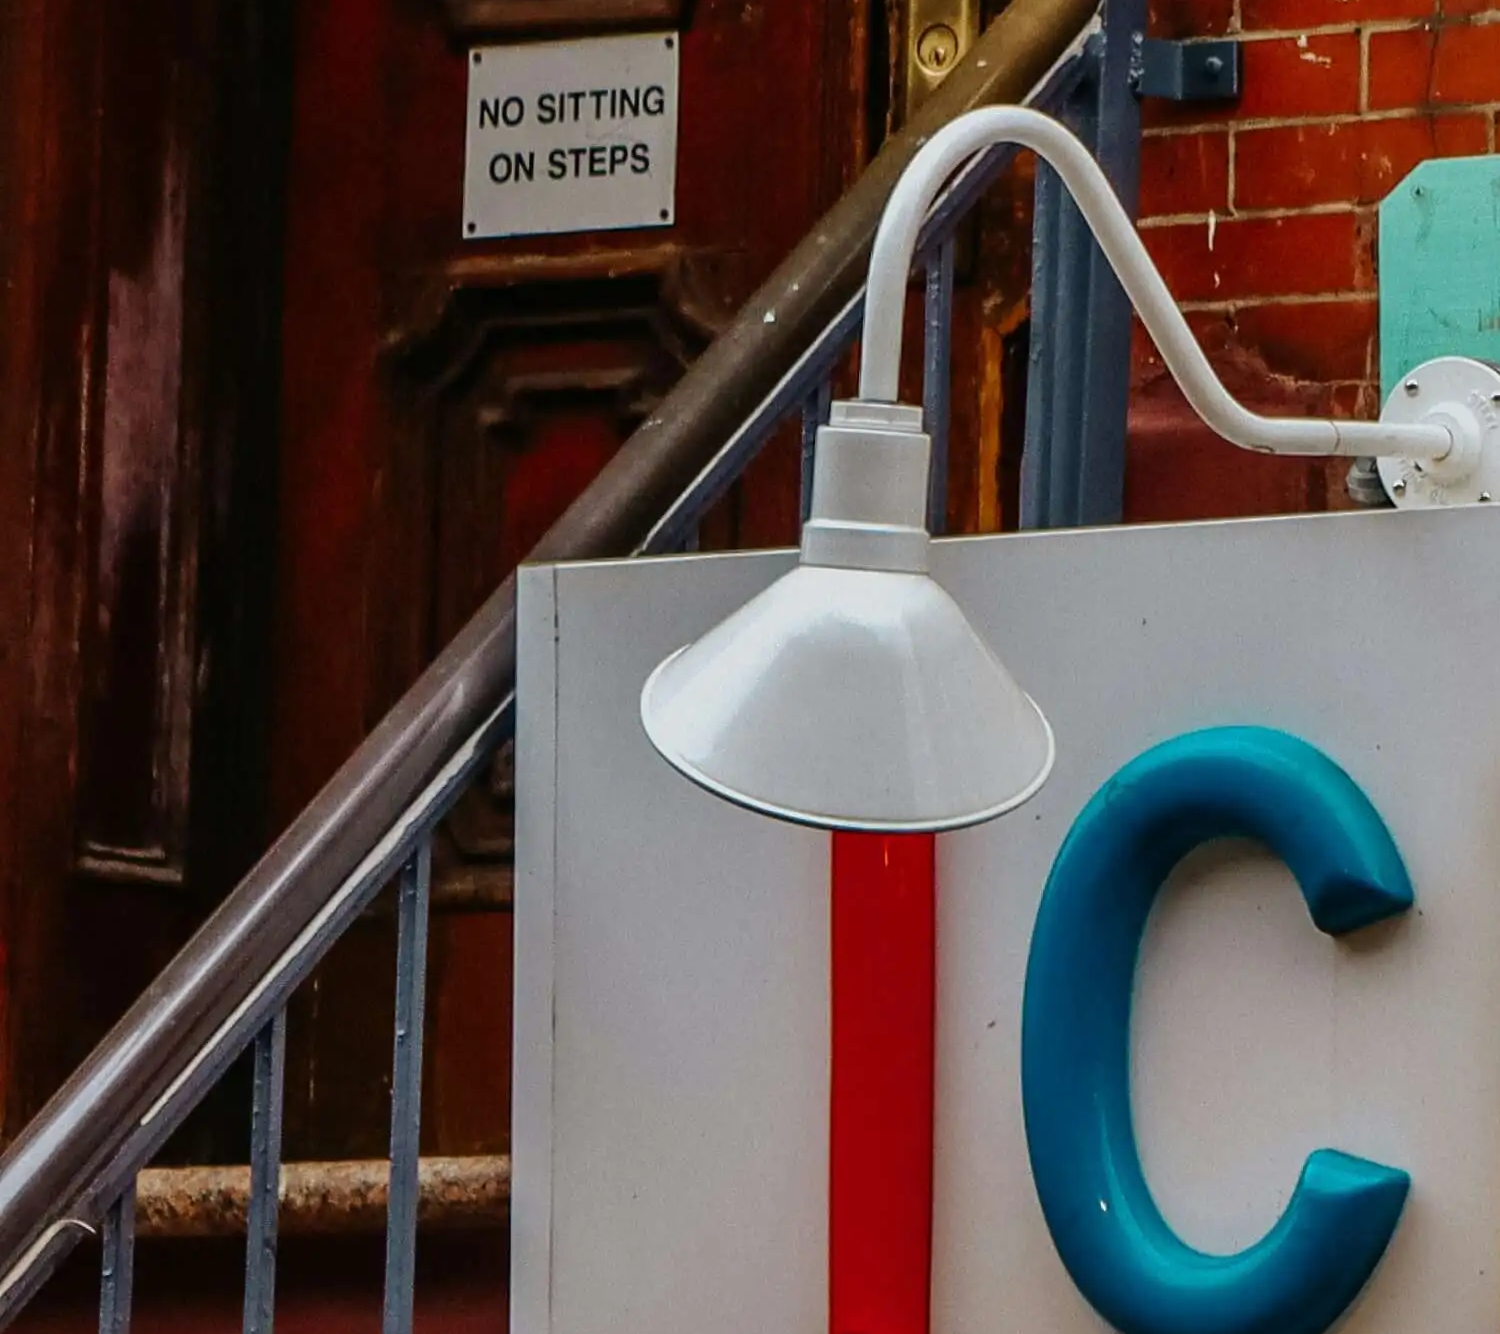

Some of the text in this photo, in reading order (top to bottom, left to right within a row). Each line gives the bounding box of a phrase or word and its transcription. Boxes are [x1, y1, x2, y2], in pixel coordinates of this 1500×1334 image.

[478, 85, 666, 129] NO SITTING
[488, 143, 651, 184] ON STEPS
